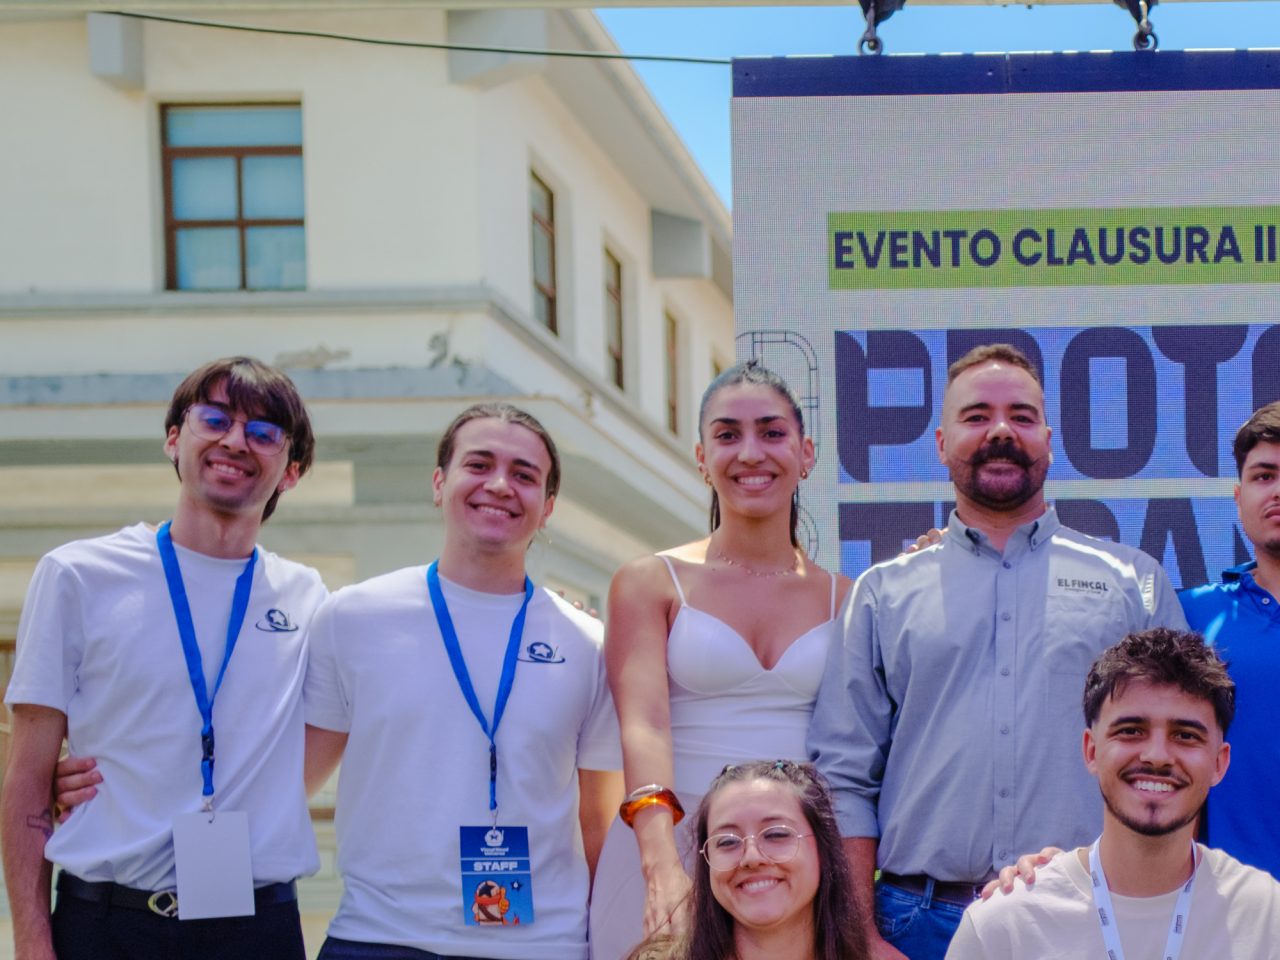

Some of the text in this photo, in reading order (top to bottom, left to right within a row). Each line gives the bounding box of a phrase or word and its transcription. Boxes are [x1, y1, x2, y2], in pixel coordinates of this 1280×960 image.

[833, 230, 1002, 270] EVENTO
[1011, 226, 1244, 267] CLAUSURA
[1253, 225, 1278, 263] II
[473, 861, 519, 872] STAFF
